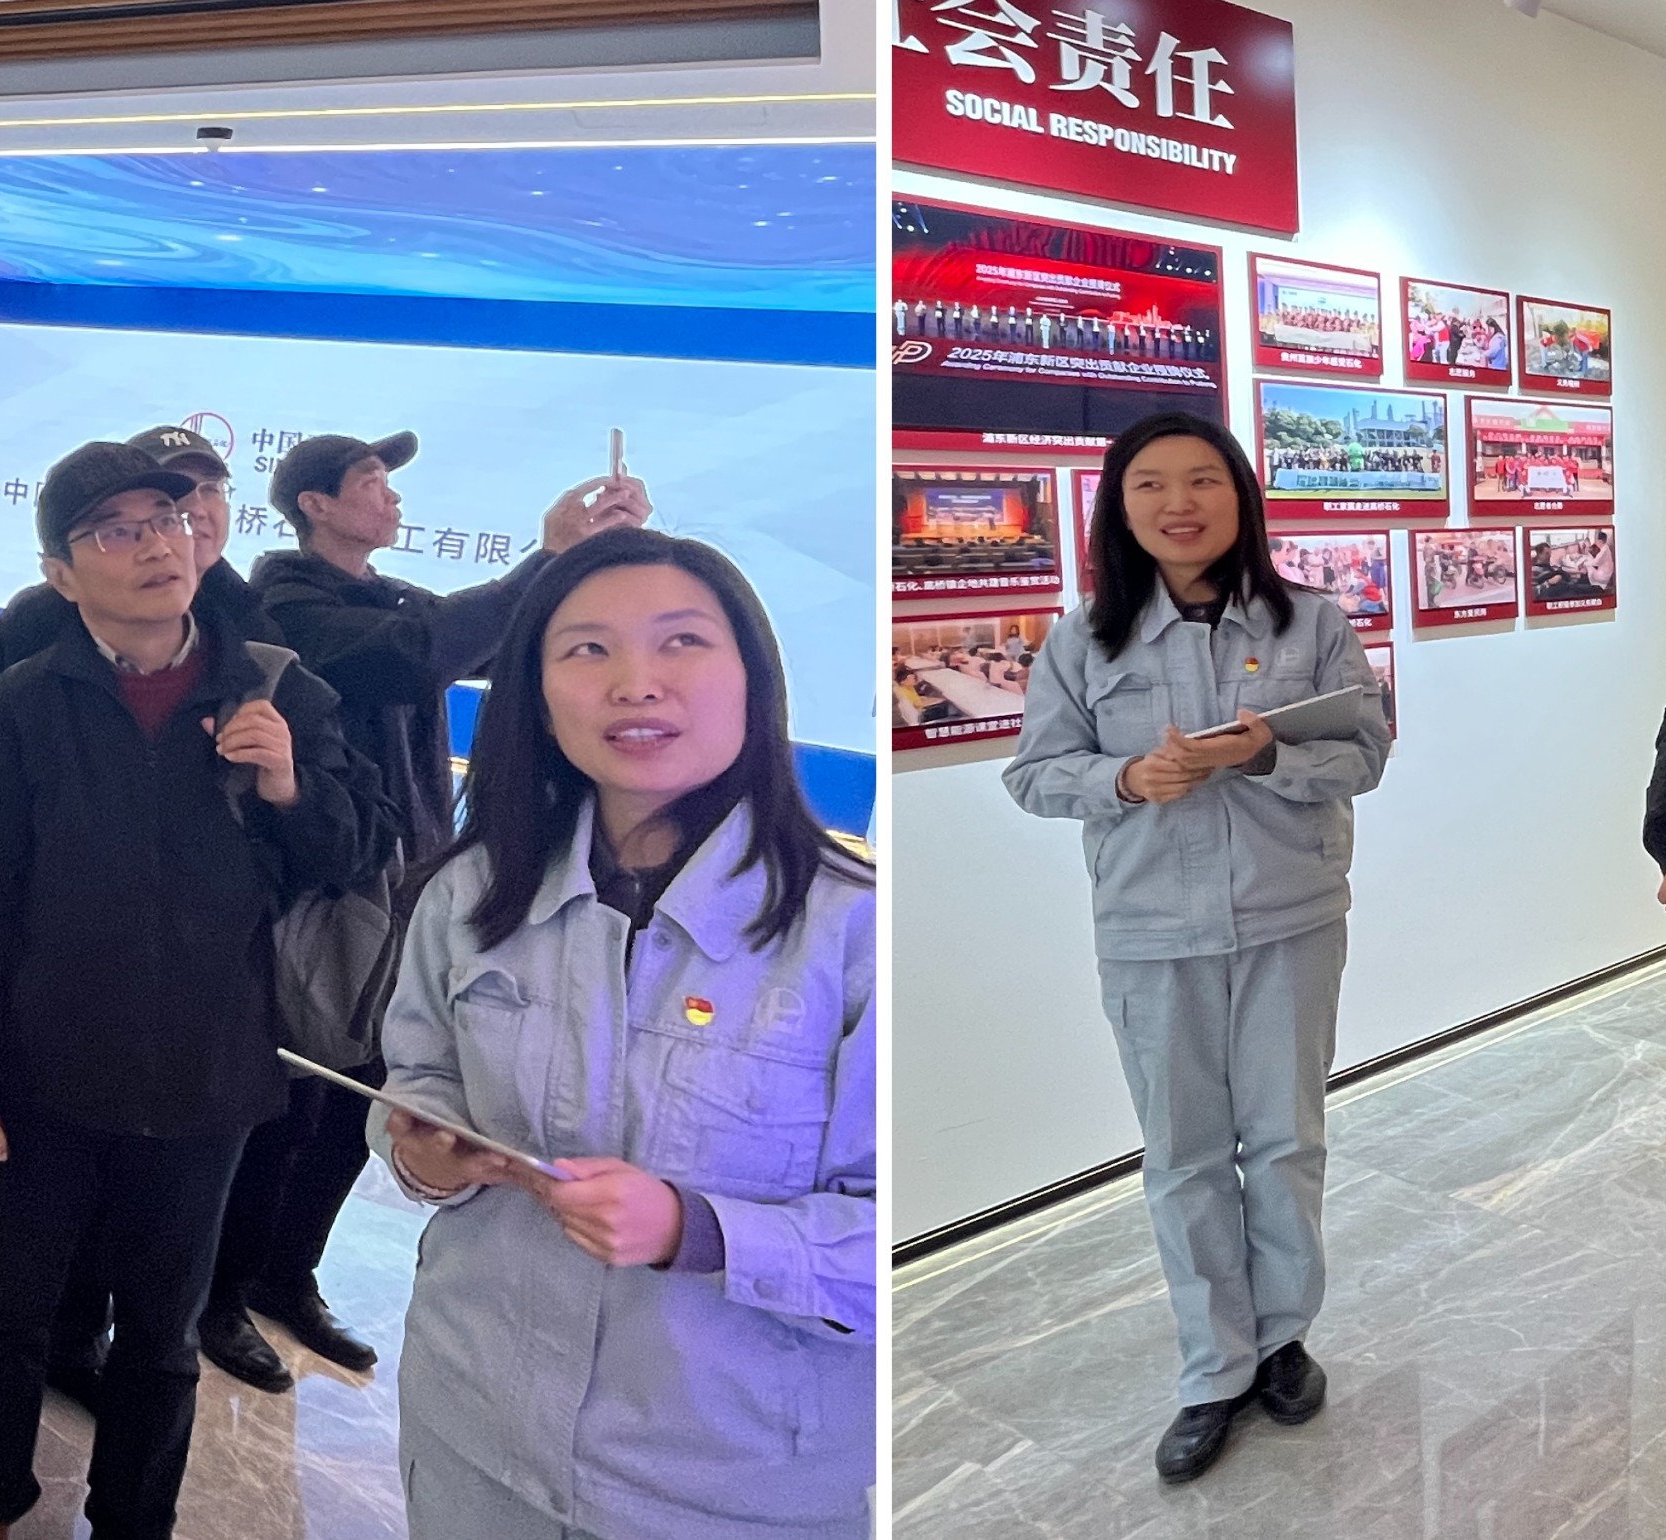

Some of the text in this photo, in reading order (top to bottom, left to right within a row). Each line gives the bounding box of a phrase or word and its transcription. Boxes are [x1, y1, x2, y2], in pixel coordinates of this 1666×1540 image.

[945, 89, 1238, 176] SOCIAL RESPONSIBILITY
[390, 524, 538, 567] 工有限
